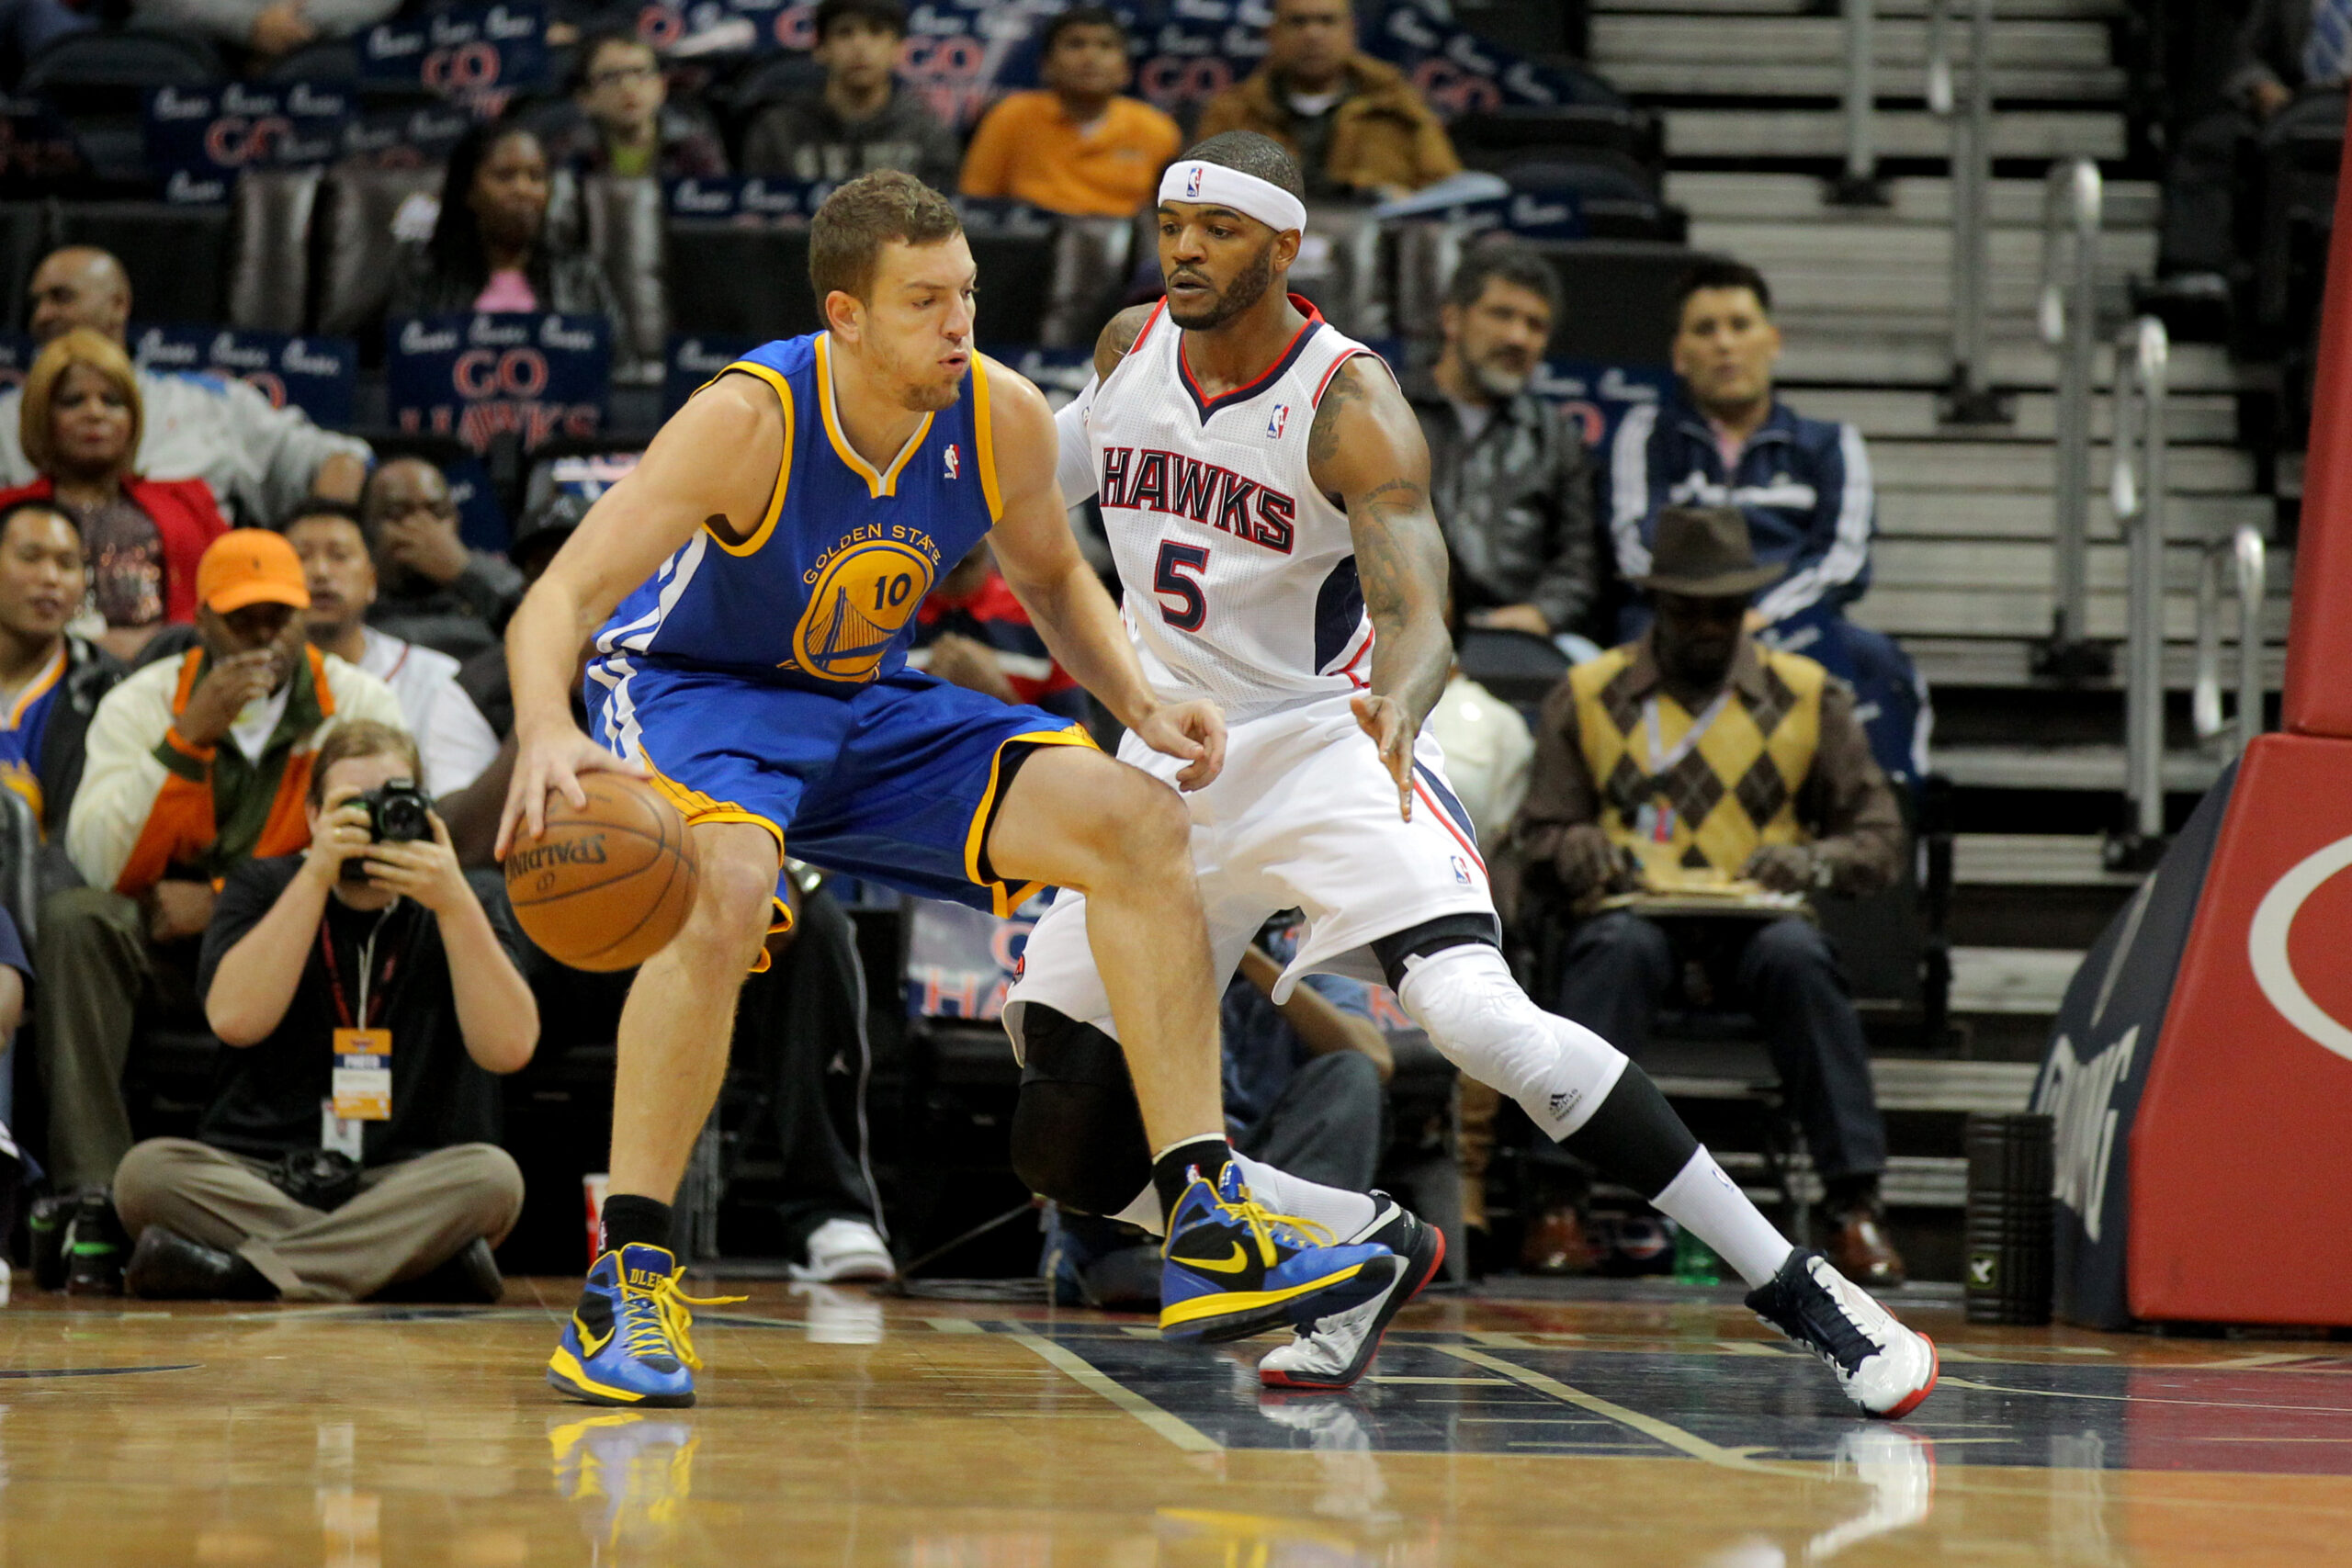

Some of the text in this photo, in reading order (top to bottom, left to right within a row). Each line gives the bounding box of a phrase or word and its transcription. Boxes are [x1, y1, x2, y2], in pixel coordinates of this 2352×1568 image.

[453, 345, 548, 399] GO
[1100, 447, 1295, 555] HAWKS
[802, 523, 942, 585] GOLDEN STATE
[875, 572, 911, 611] 10
[1154, 538, 1211, 633] 5
